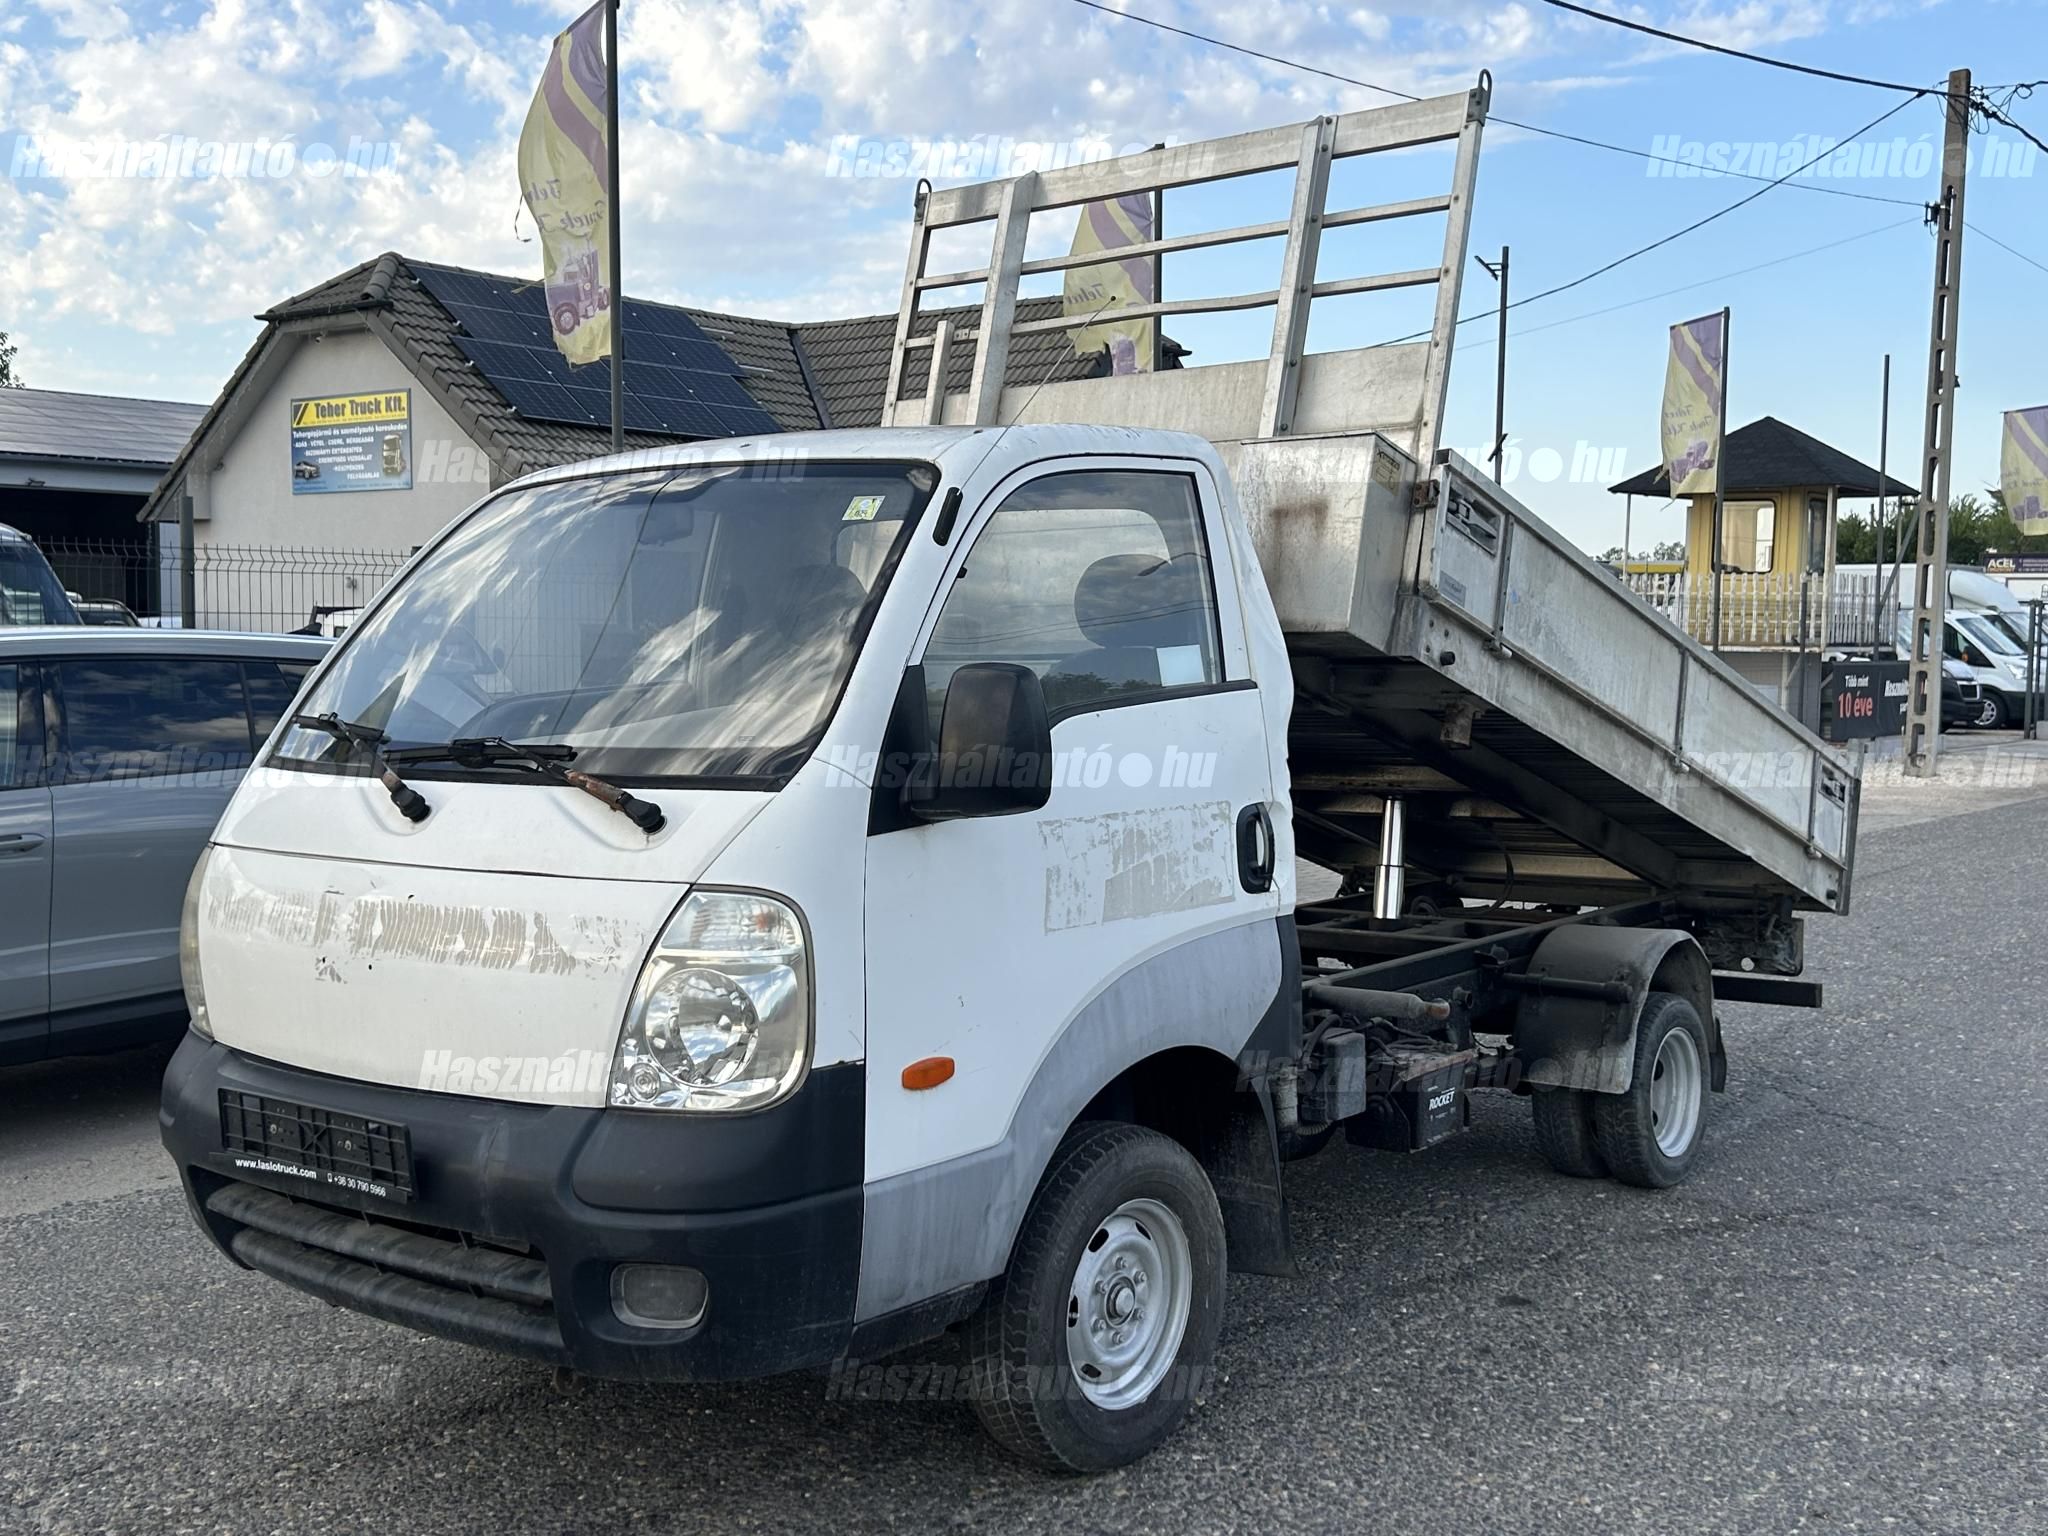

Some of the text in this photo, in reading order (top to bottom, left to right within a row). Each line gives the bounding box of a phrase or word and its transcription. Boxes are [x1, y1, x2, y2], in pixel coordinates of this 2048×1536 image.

[314, 395, 406, 419] Teher Truck Kft.
[1838, 690, 1873, 718] 10 éve
[1428, 1091, 1455, 1111] ROCKET
